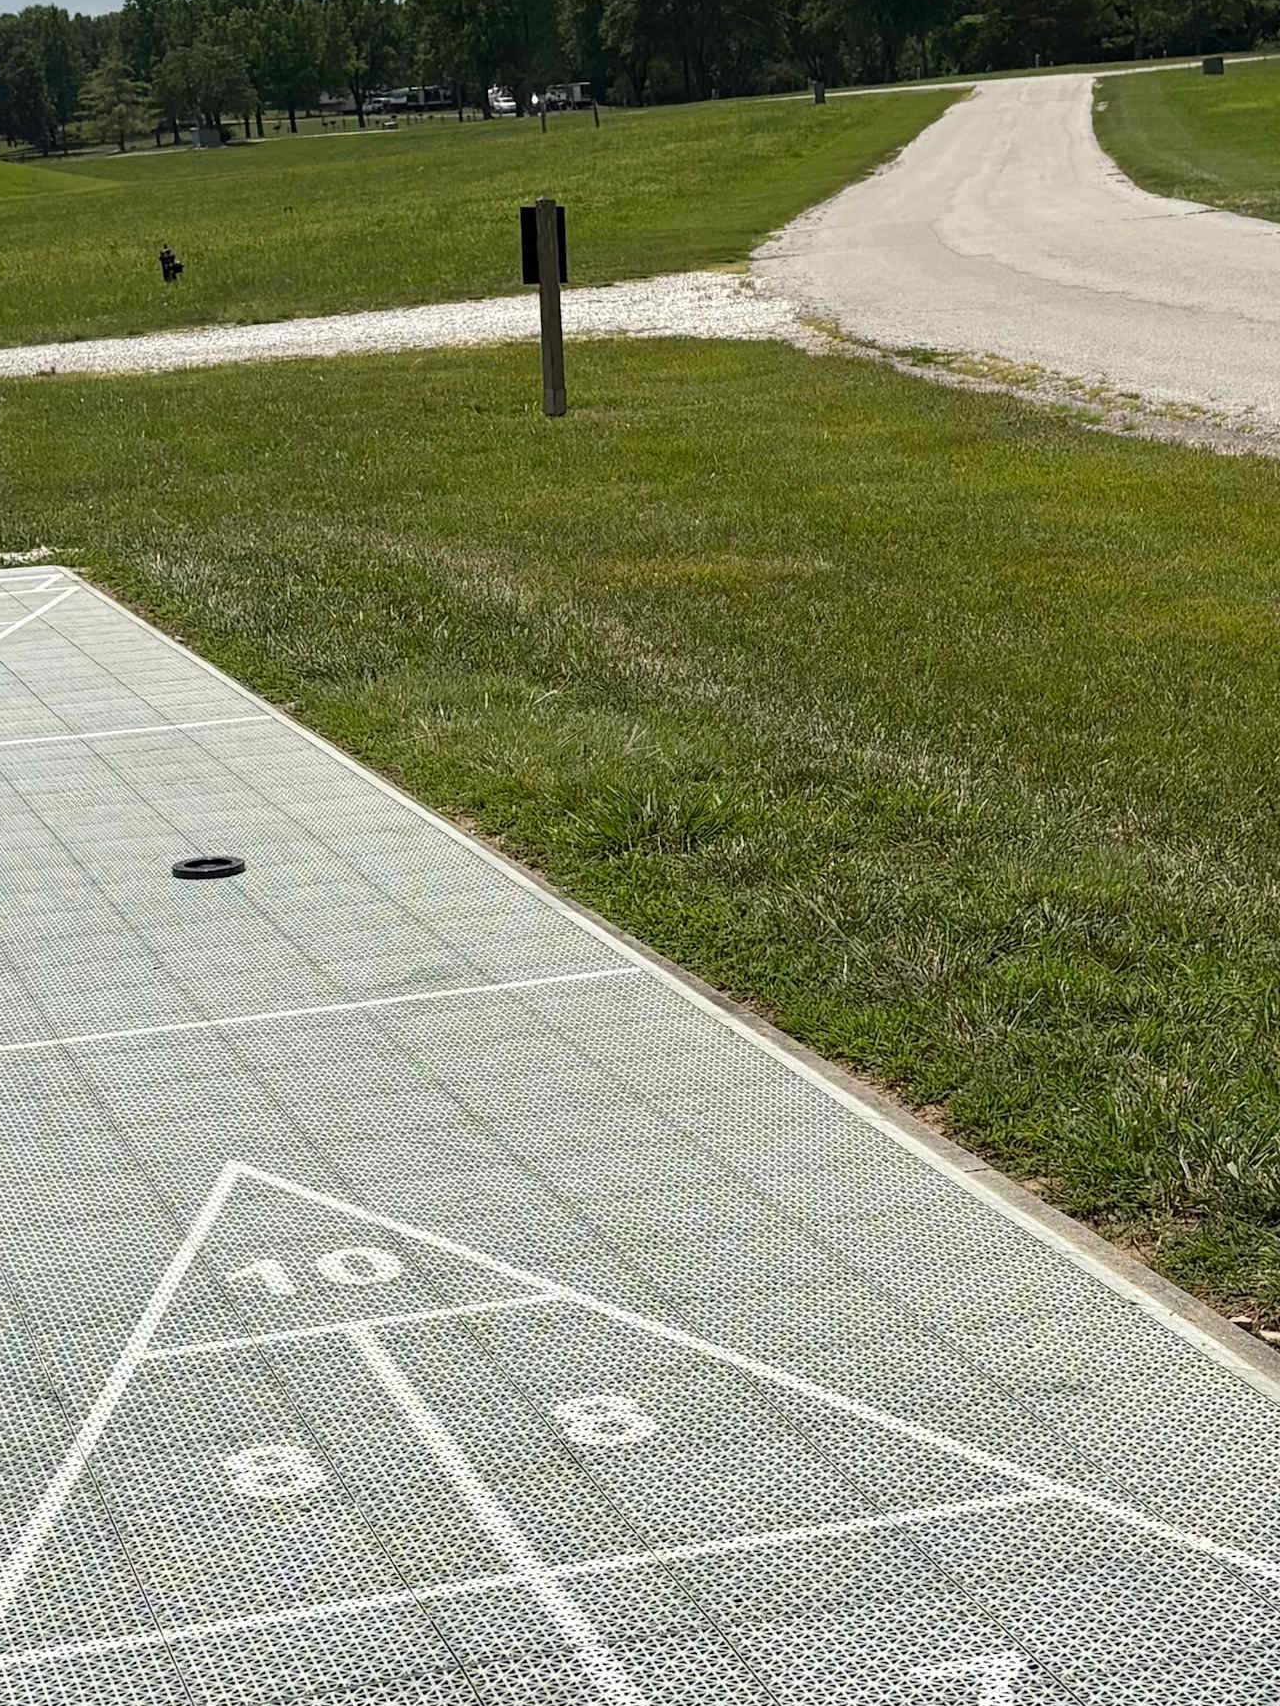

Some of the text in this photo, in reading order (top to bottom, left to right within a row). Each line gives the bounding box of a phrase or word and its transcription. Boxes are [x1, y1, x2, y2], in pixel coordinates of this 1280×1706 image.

[224, 1247, 403, 1295] 10
[552, 1393, 659, 1448] 8
[221, 1444, 326, 1497] 8
